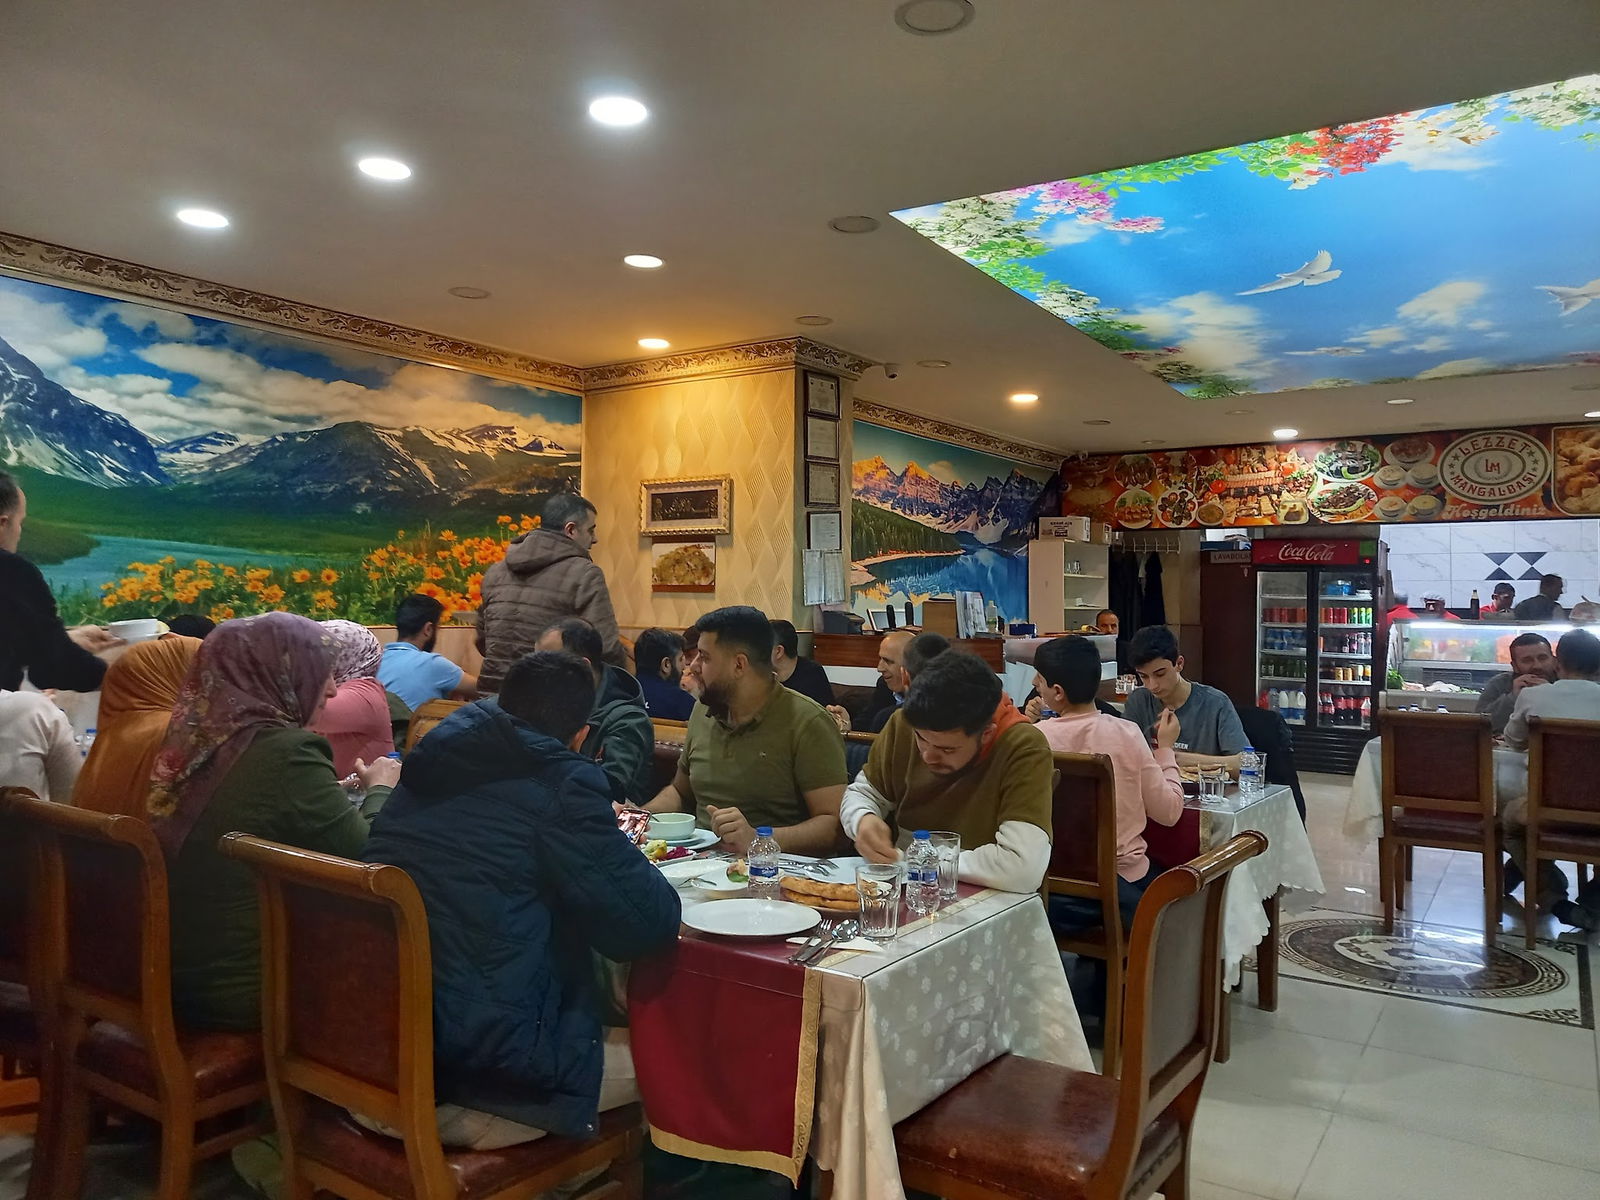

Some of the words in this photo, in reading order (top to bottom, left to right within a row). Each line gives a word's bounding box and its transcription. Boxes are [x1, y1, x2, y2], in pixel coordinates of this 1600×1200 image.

[1458, 436, 1532, 456] LEZZET
[1450, 472, 1538, 498] MANGALBAŞI
[1442, 503, 1547, 520] Hoşgeldiniz
[1213, 550, 1251, 561] LAVABOLA
